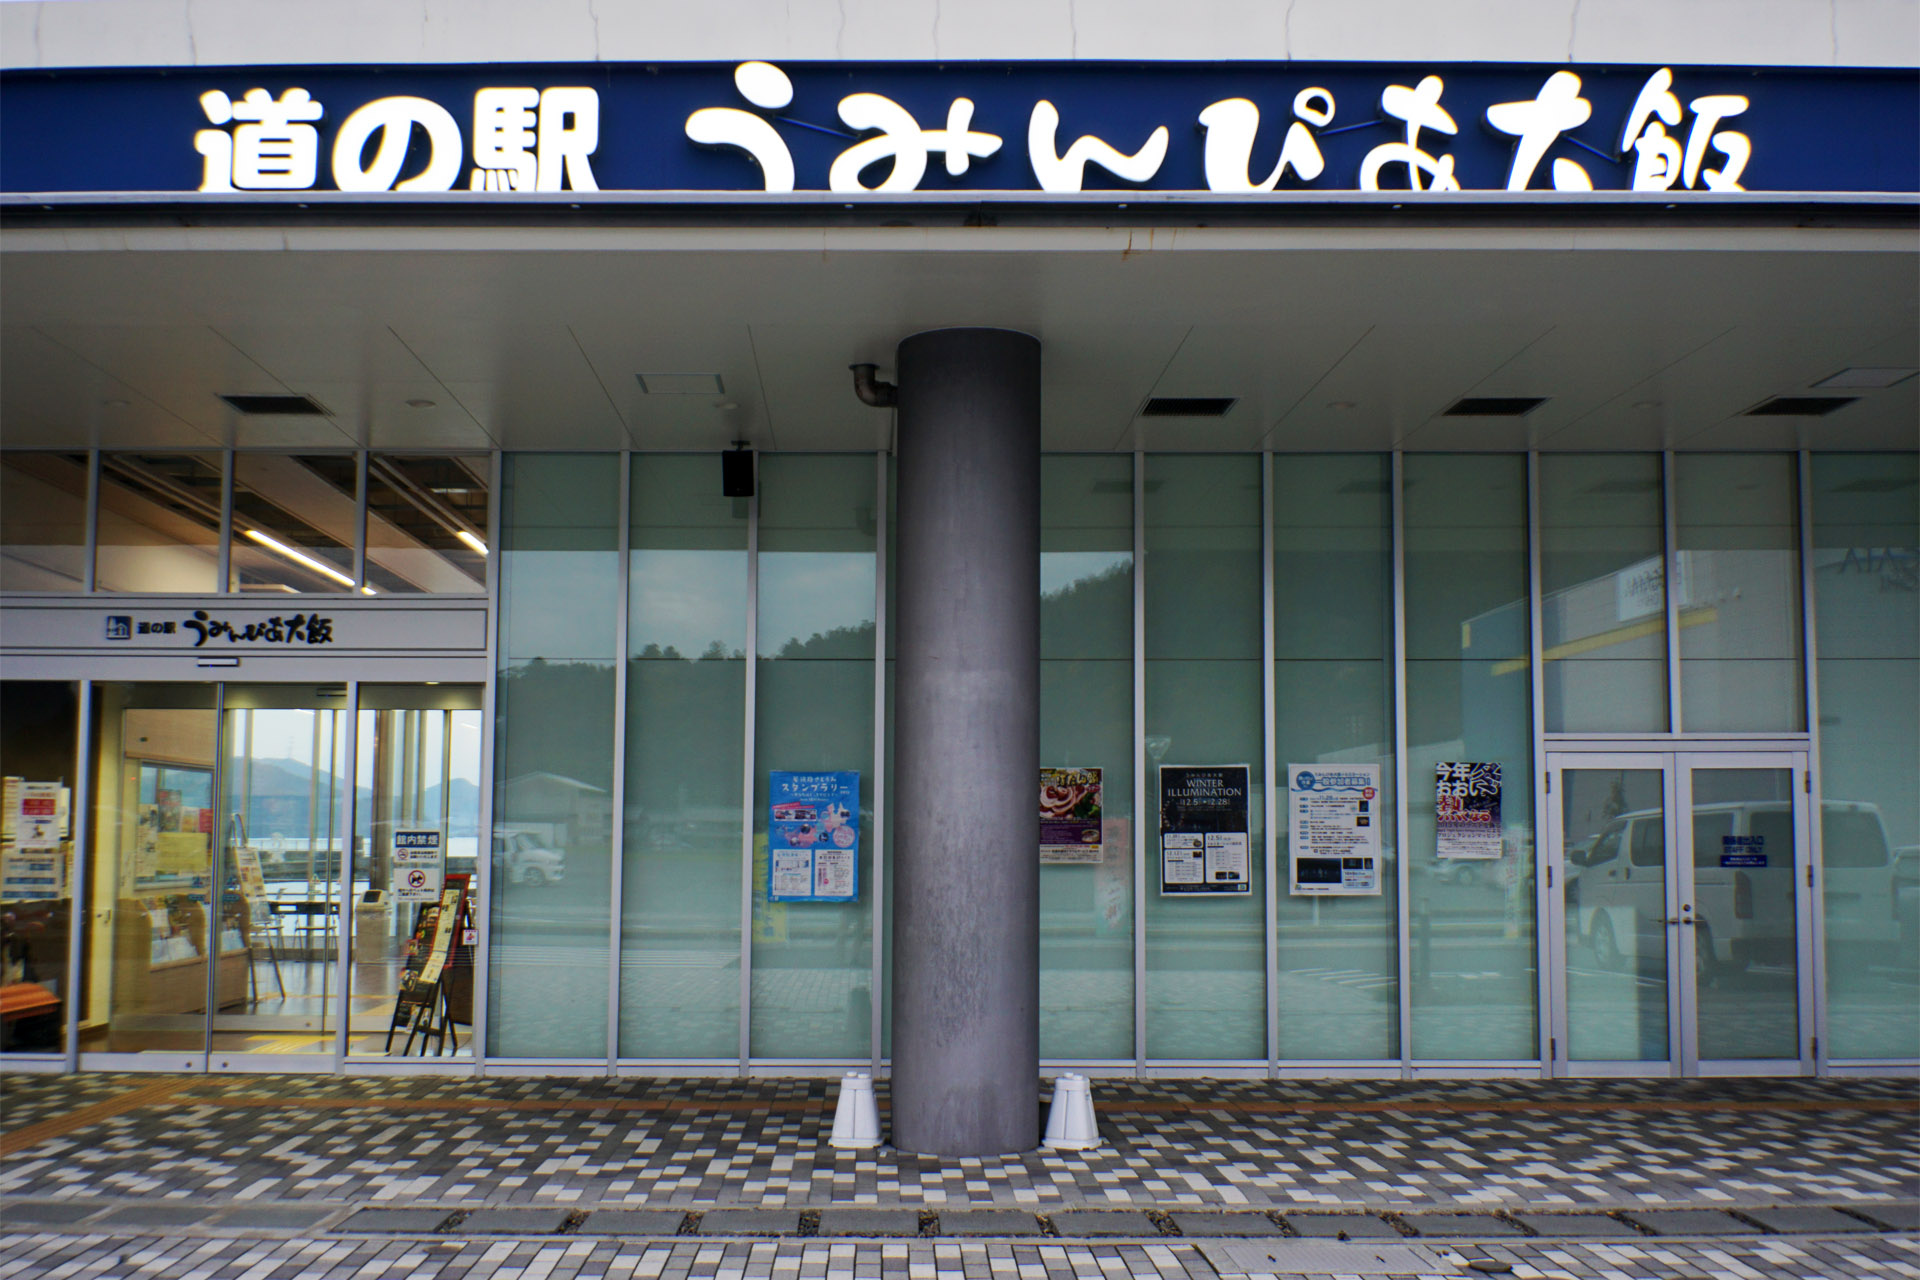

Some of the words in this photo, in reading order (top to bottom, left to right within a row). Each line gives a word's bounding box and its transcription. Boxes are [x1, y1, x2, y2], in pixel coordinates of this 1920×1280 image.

[194, 86, 599, 191] 道の駅
[685, 61, 1752, 191] うみんぴあ大飯
[138, 620, 175, 634] 道の駅
[183, 610, 332, 647] うみんぴあ大飯
[1186, 779, 1224, 788] WINTER
[1167, 787, 1242, 797] ILLUMINATION
[396, 834, 438, 845] 館内禁煙
